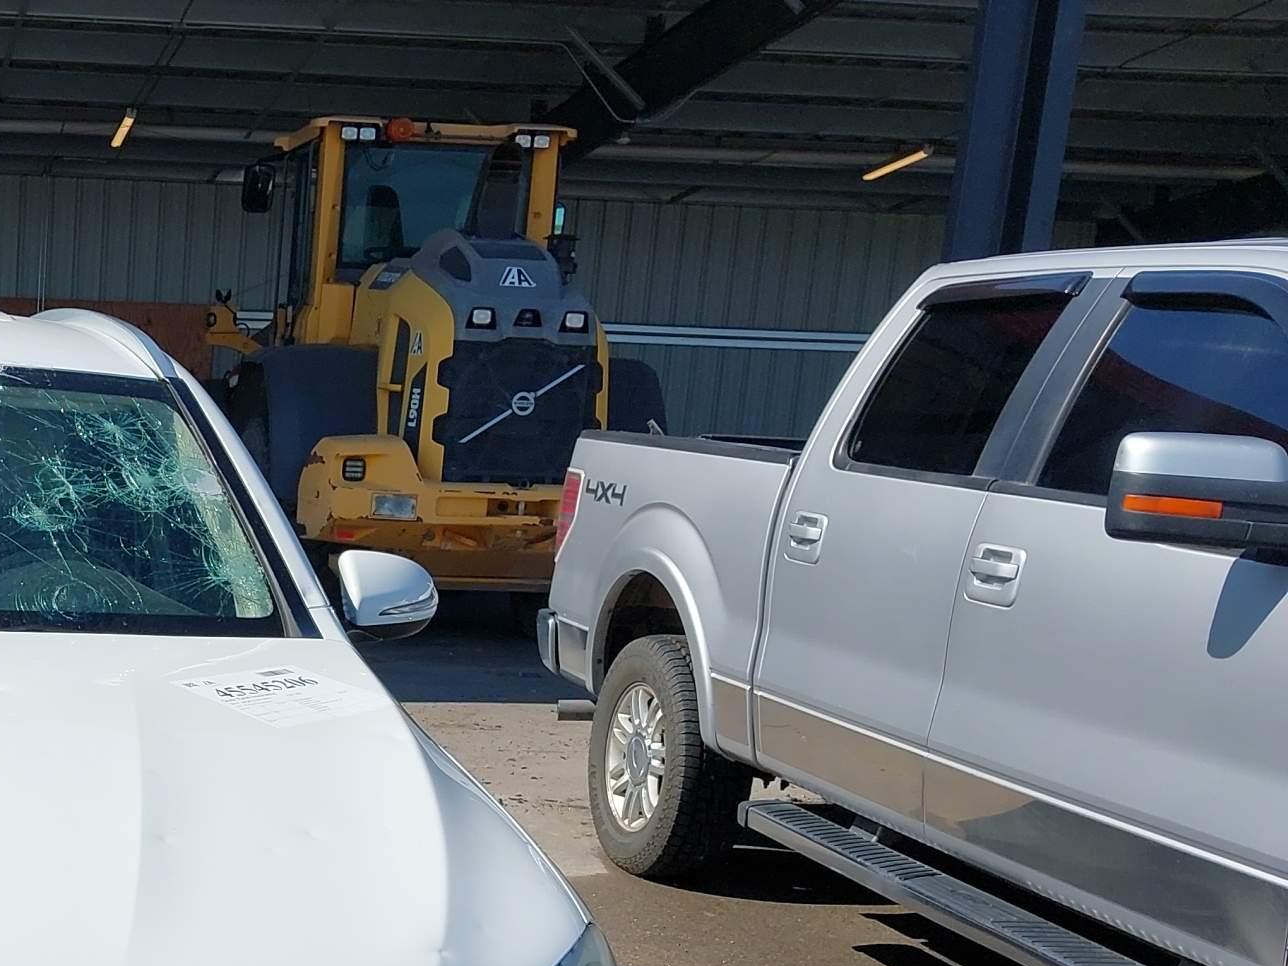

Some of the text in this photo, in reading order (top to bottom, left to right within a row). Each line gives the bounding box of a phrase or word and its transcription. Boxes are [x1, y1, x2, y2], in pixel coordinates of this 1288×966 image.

[499, 266, 537, 287] IAA
[407, 388, 422, 427] L90H
[215, 676, 319, 697] 45545206
